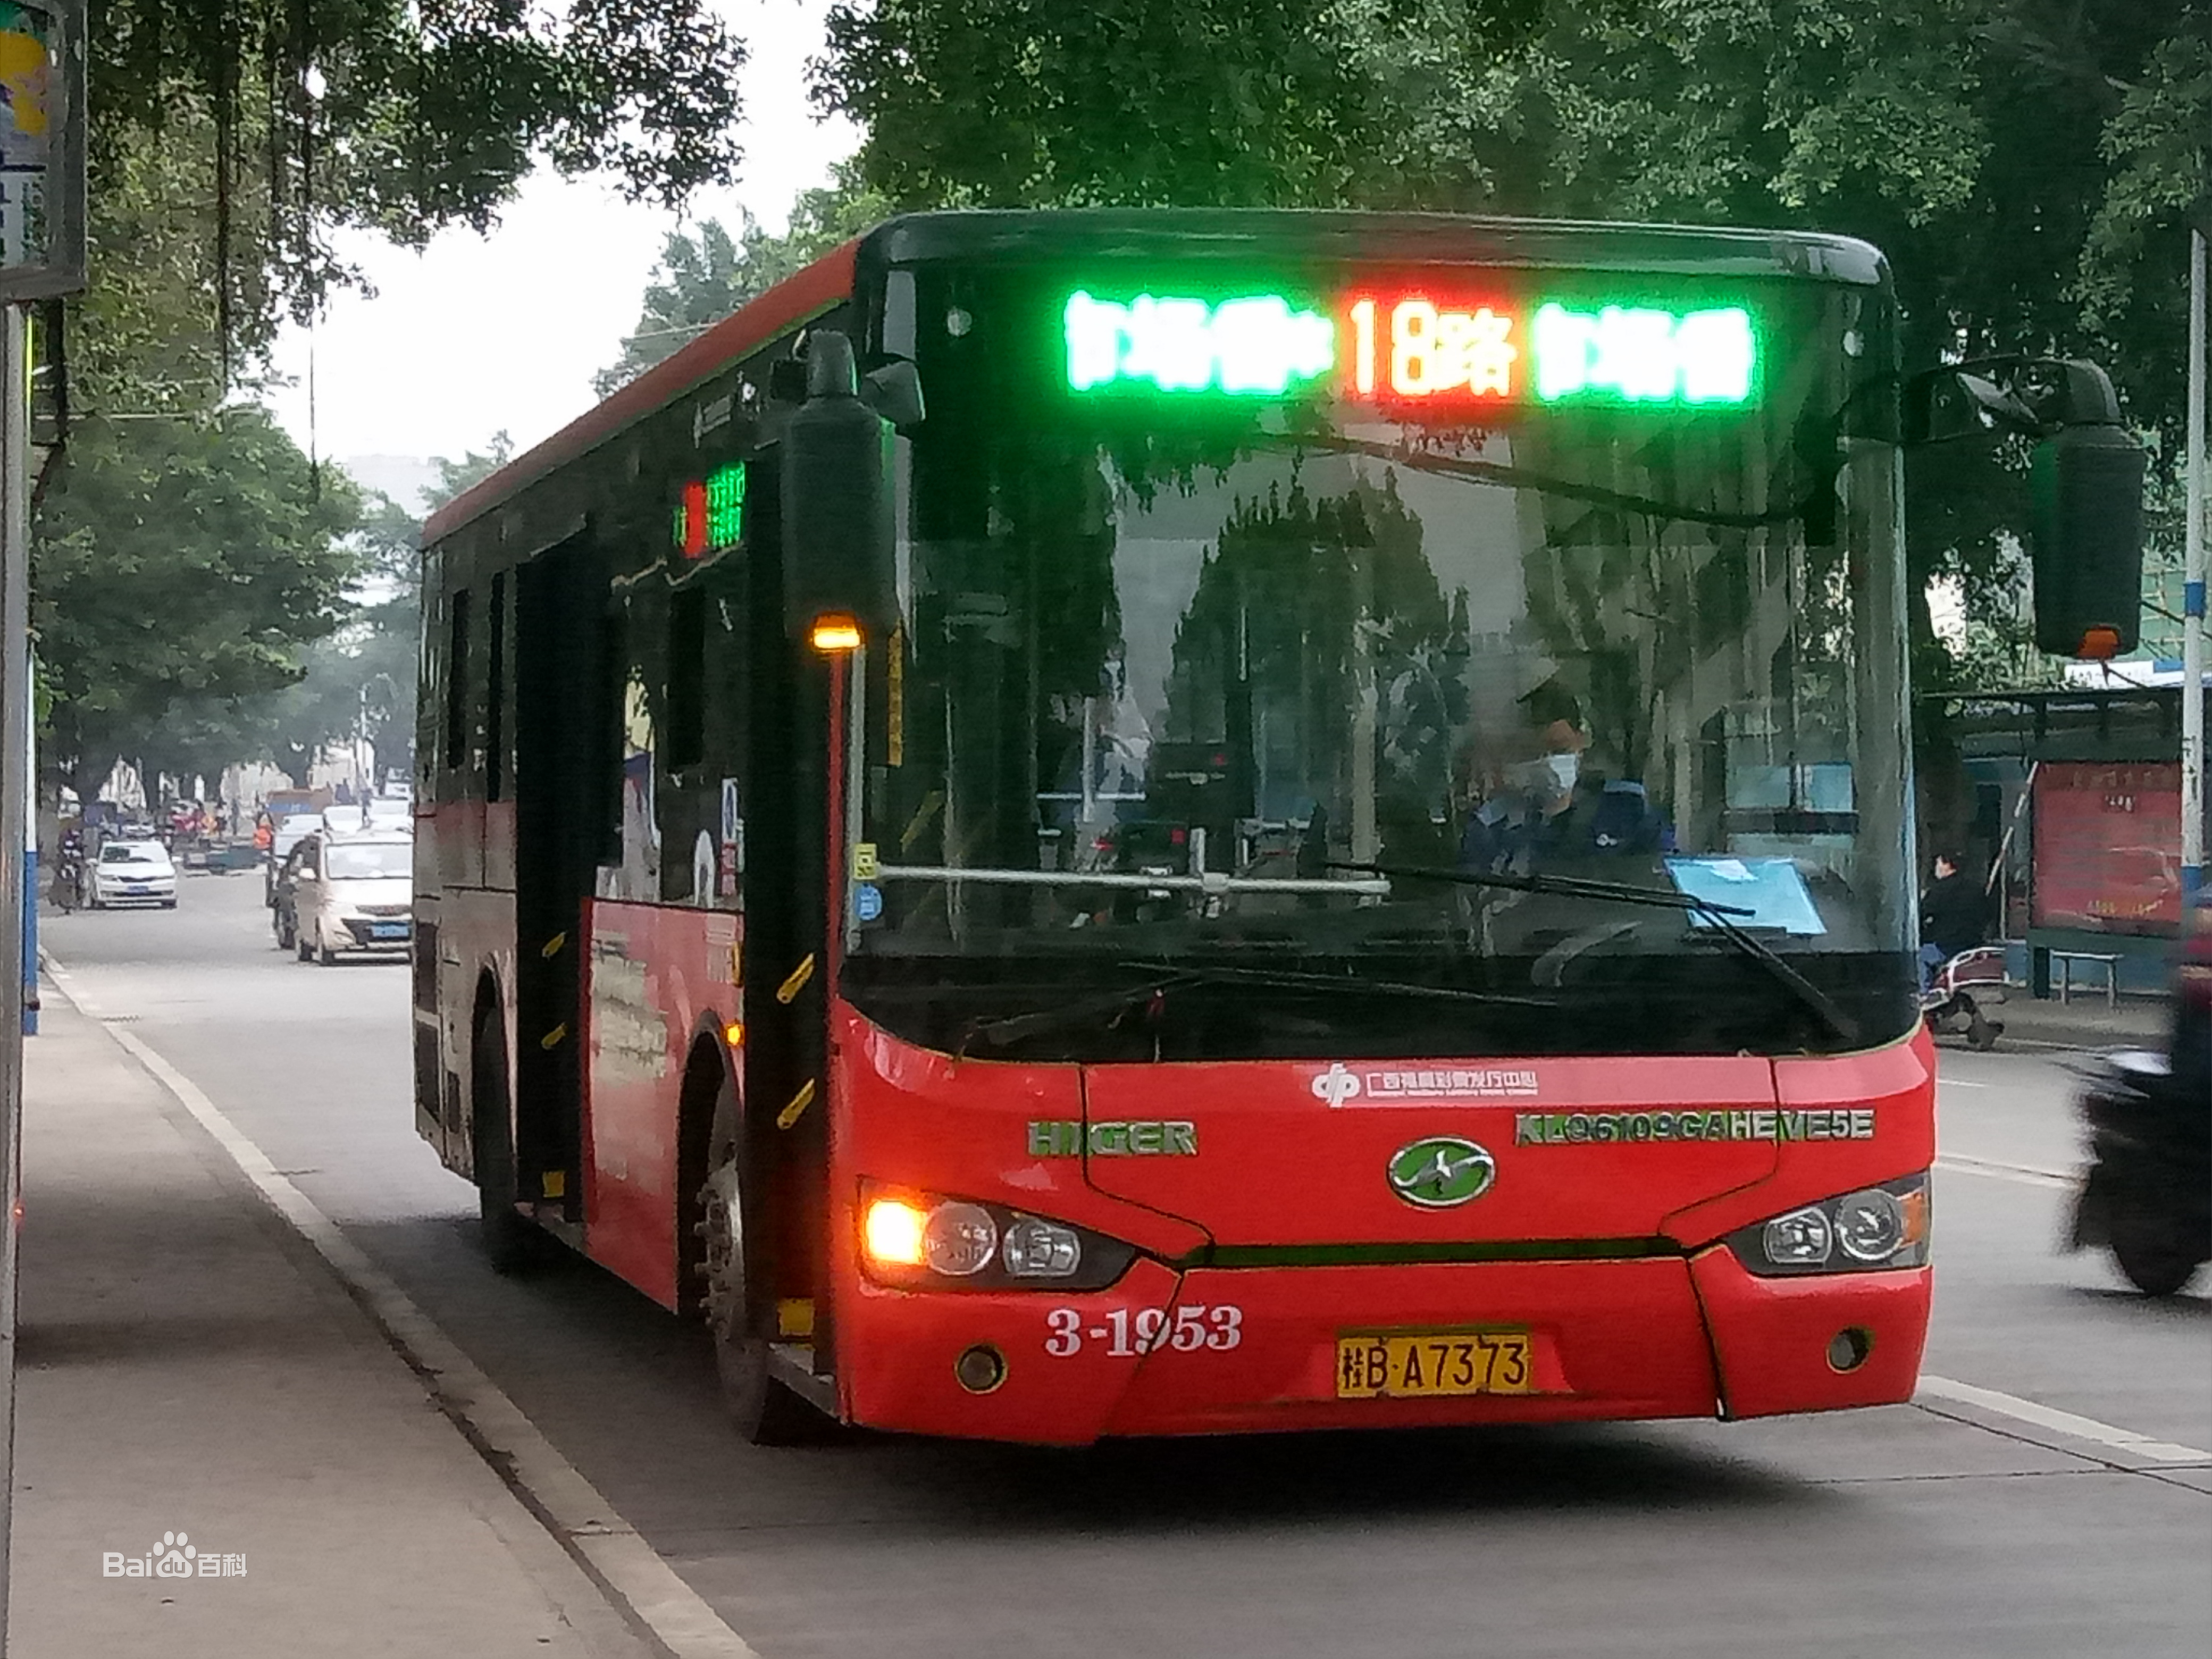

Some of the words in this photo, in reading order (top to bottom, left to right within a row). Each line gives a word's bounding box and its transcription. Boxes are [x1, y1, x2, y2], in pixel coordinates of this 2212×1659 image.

[1350, 299, 1518, 396] 18路
[1028, 1121, 1197, 1155] HIGER
[1045, 1304, 1243, 1357] 3-1953
